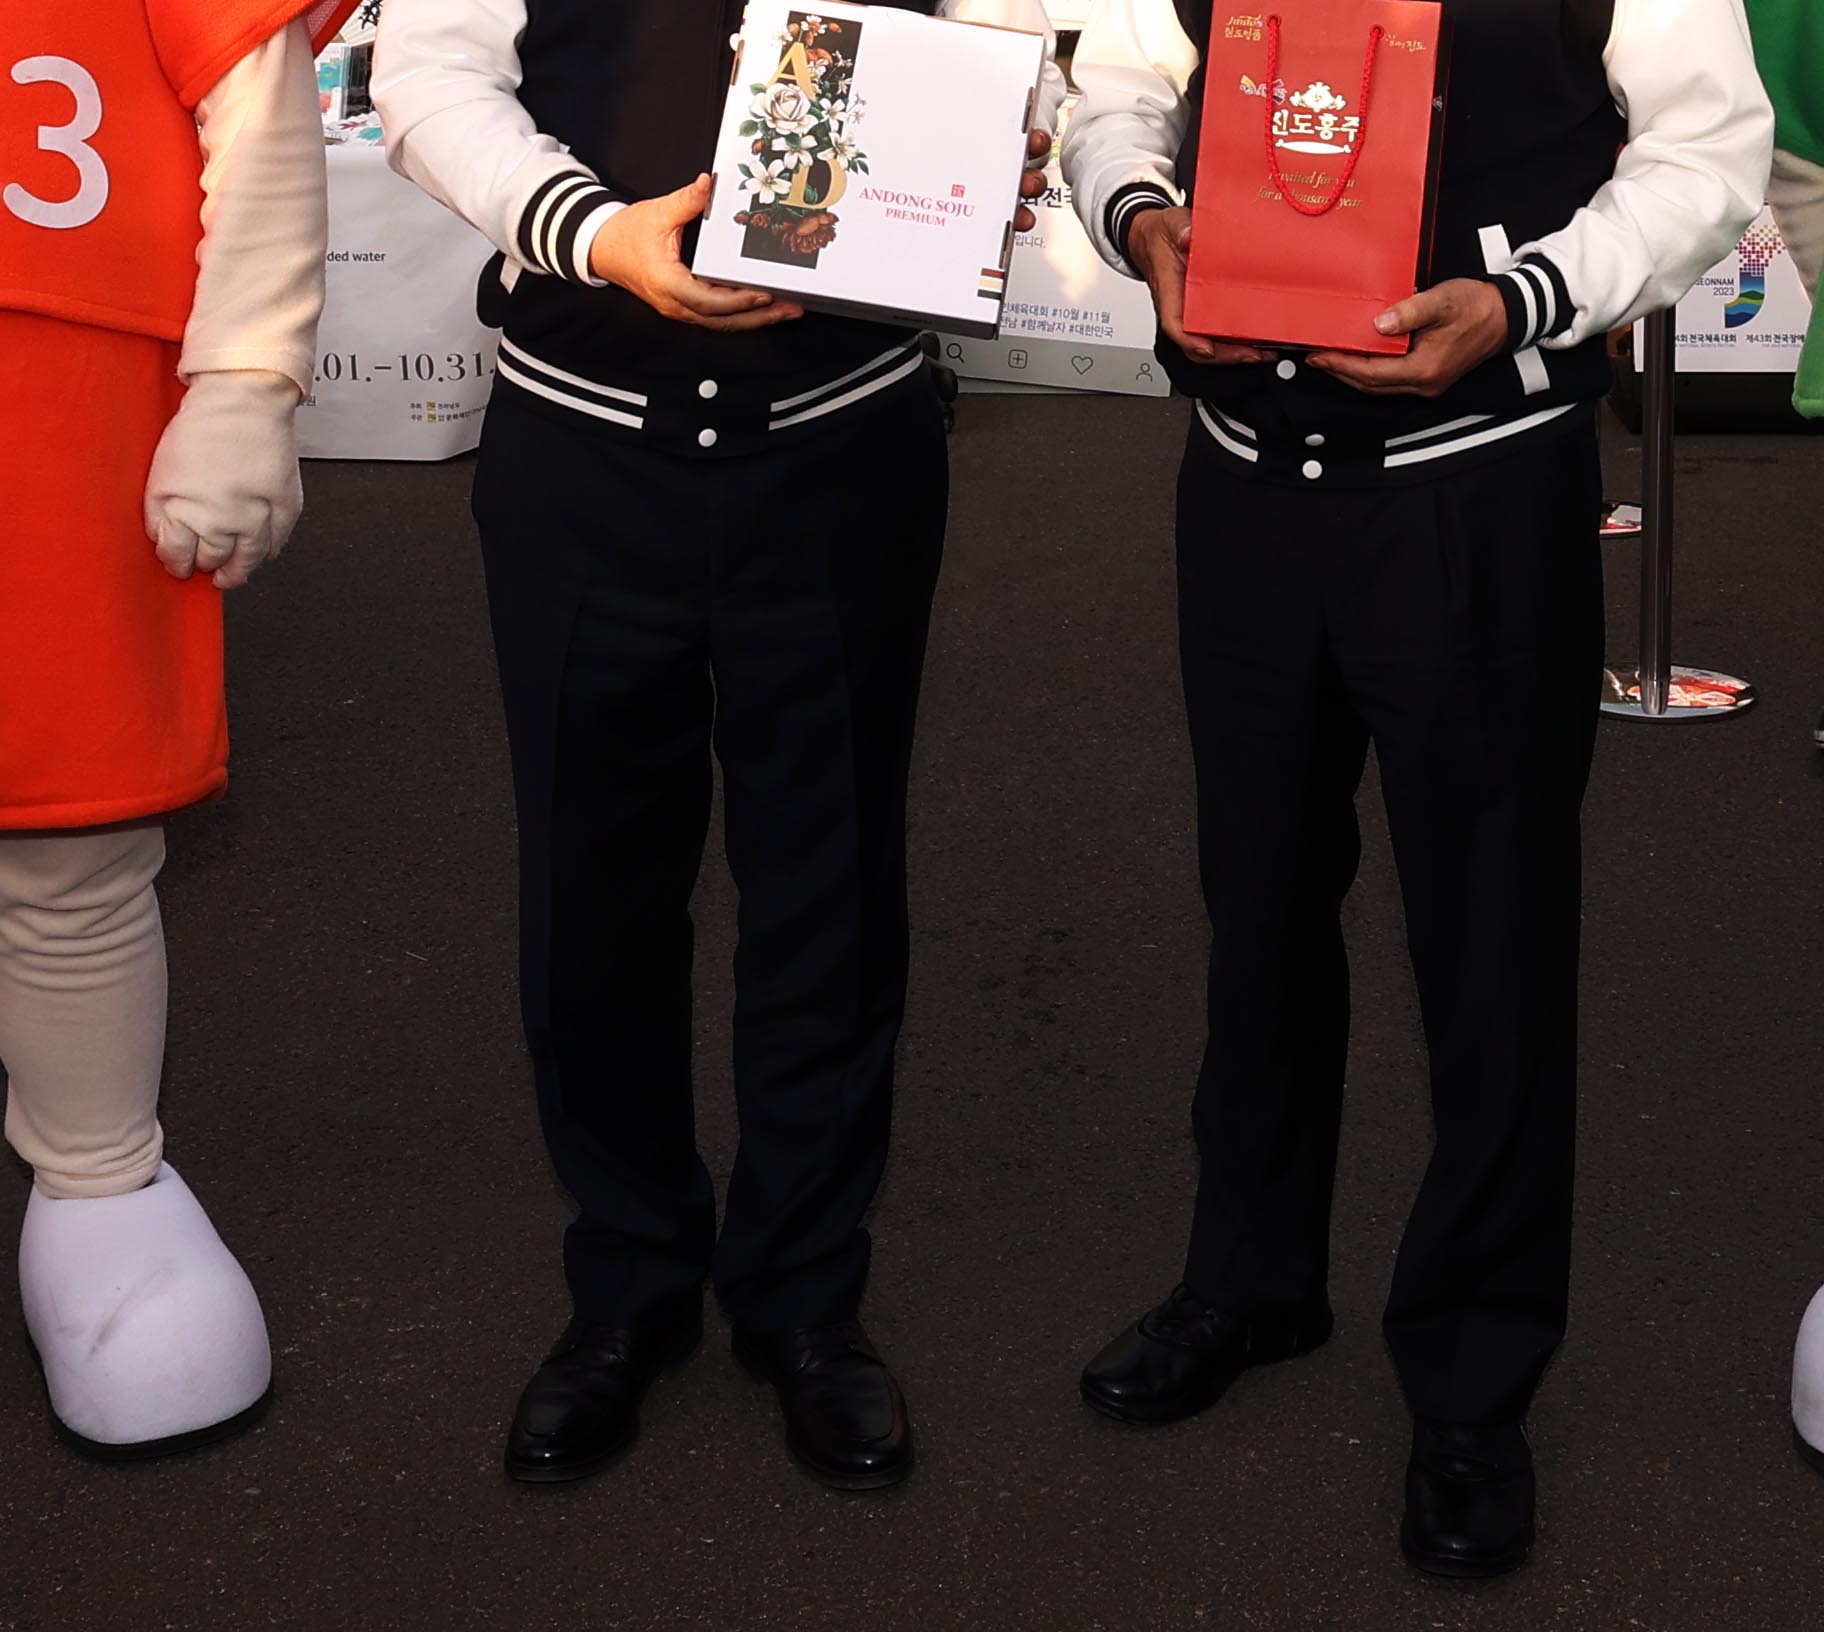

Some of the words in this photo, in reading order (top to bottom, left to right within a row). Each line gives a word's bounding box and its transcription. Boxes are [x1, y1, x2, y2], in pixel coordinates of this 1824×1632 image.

[859, 187, 933, 210] ANDONG
[935, 199, 976, 218] SOJU
[885, 207, 946, 228] PREMIUM
[352, 252, 386, 263] water
[1713, 287, 1734, 296] 2023
